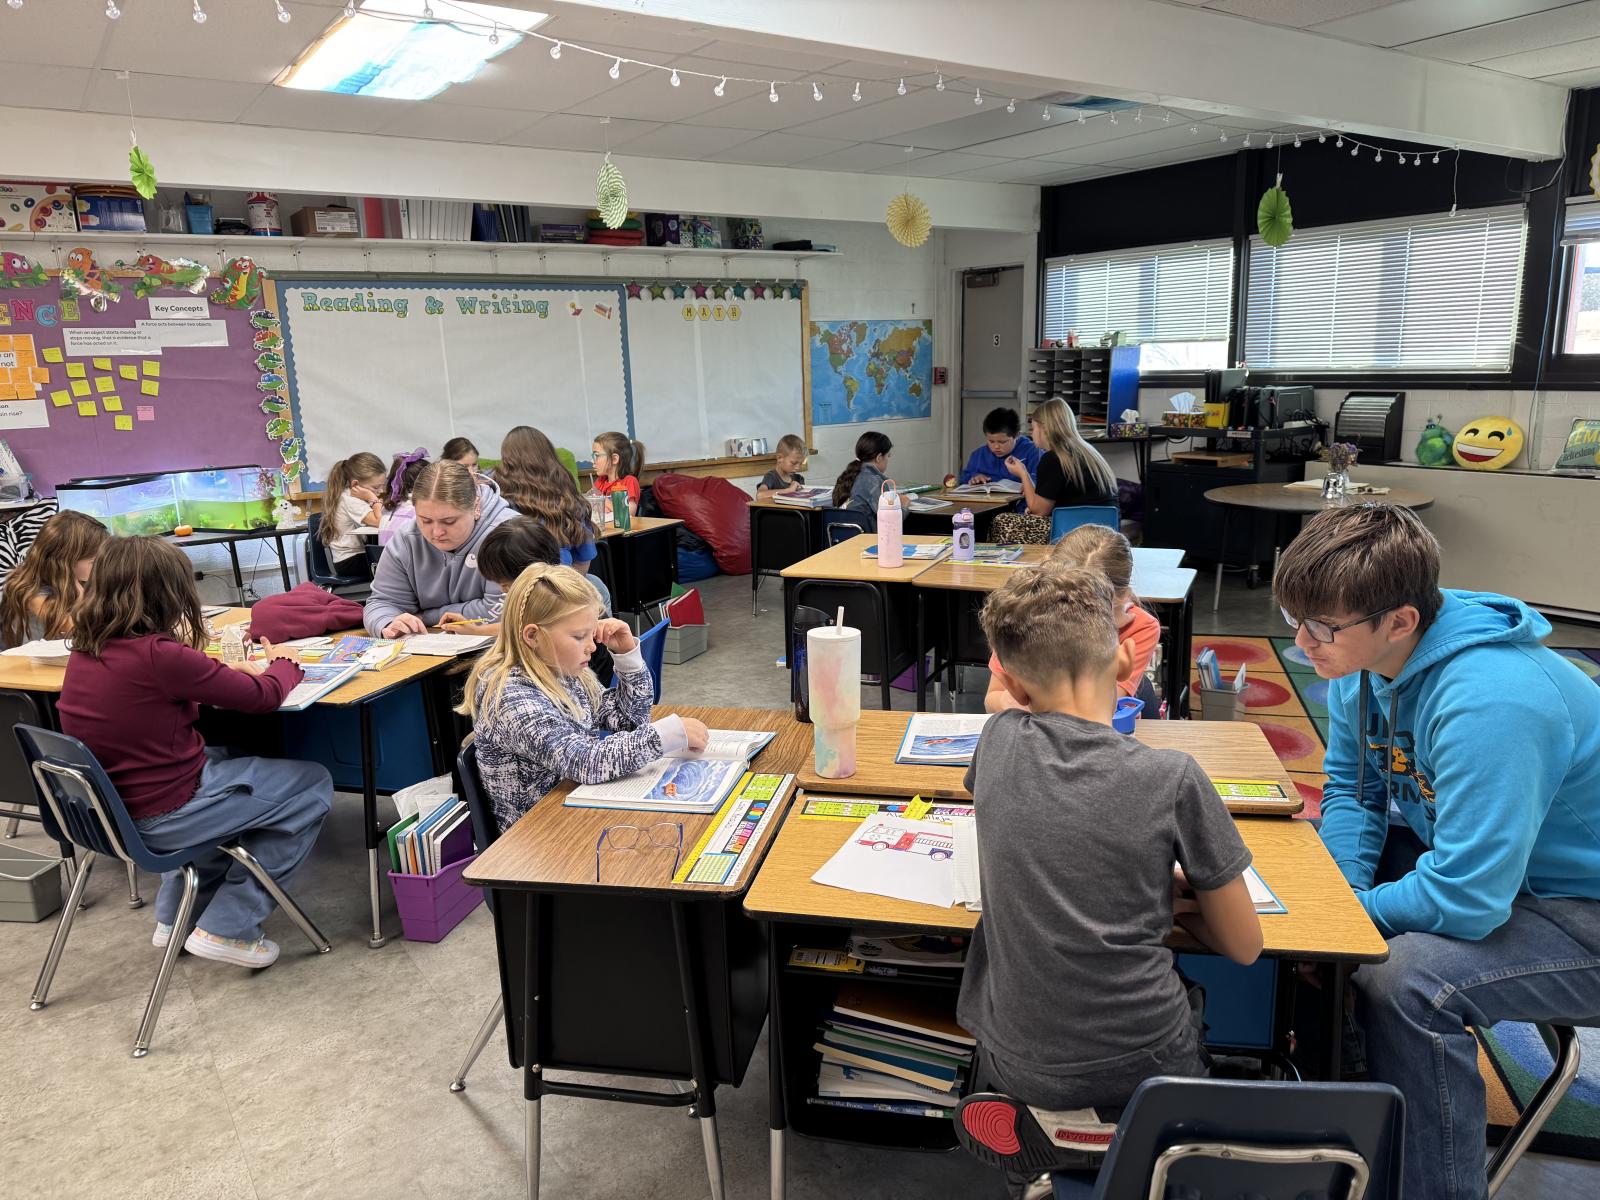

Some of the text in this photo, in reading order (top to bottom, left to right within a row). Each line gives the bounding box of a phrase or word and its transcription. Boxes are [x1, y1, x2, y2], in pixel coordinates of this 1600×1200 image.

[155, 305, 204, 313] Key Concepts
[301, 292, 549, 319] Reading & Writing
[686, 307, 737, 317] MATH
[994, 335, 1000, 346] 3
